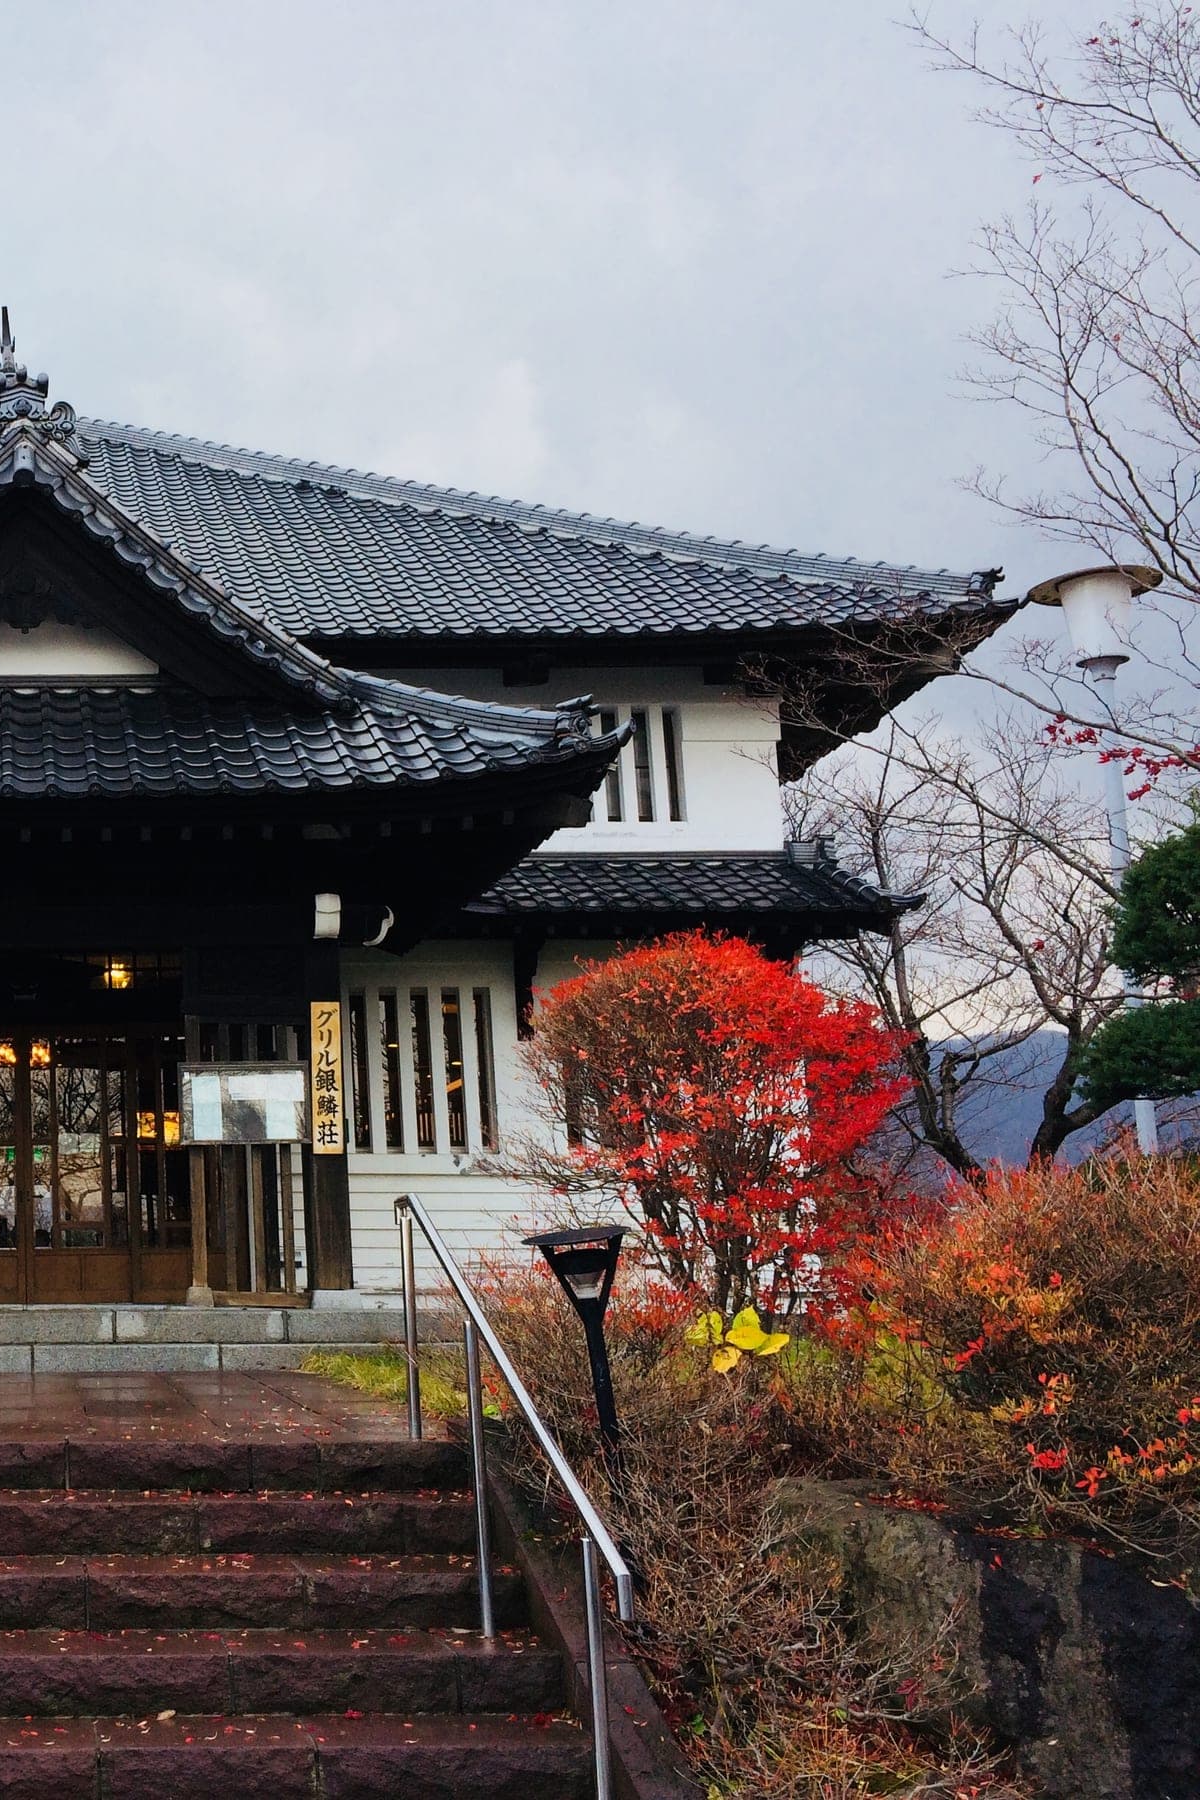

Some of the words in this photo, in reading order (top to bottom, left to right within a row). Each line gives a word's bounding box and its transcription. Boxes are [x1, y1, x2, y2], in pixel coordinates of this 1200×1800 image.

[316, 1009, 339, 1146] グリル銀鱗荘
